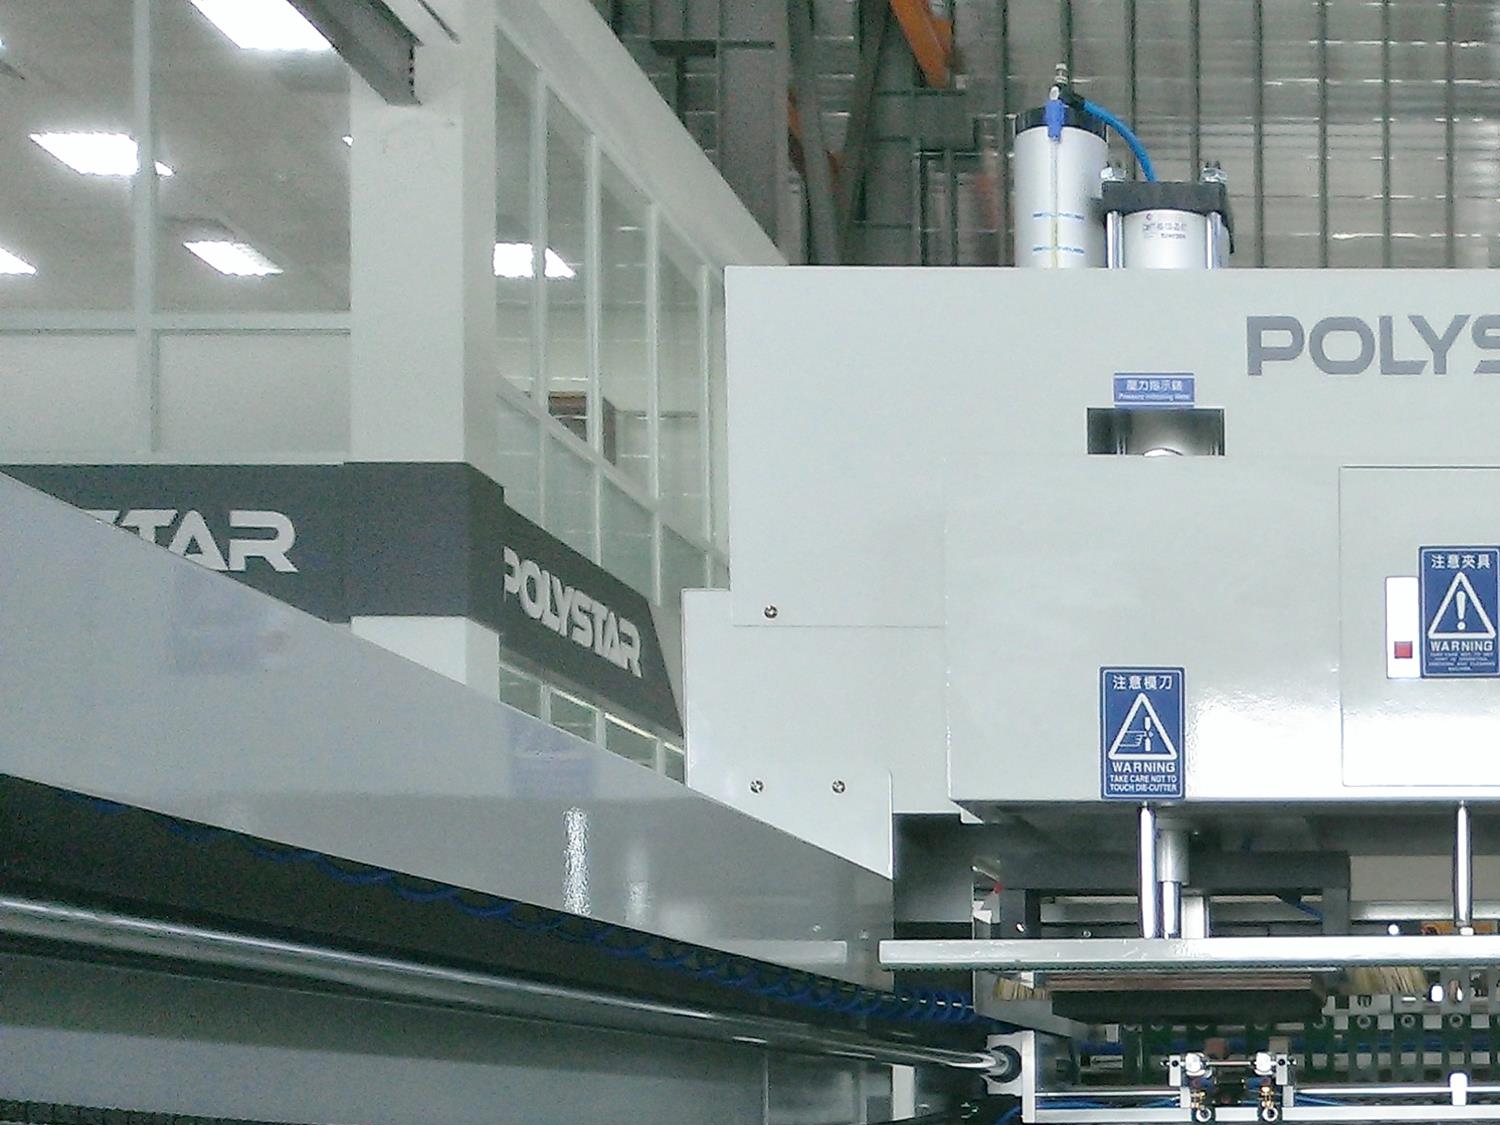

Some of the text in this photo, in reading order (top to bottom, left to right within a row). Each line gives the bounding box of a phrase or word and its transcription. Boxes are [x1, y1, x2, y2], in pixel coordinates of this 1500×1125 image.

[86, 508, 299, 572] TAR
[1431, 554, 1491, 569] 注意夾具
[503, 545, 643, 679] POLYSTAR
[1430, 641, 1493, 652] WARNING
[1112, 762, 1176, 773] WARNING
[1110, 775, 1177, 783] TAKE CARE NOT TO
